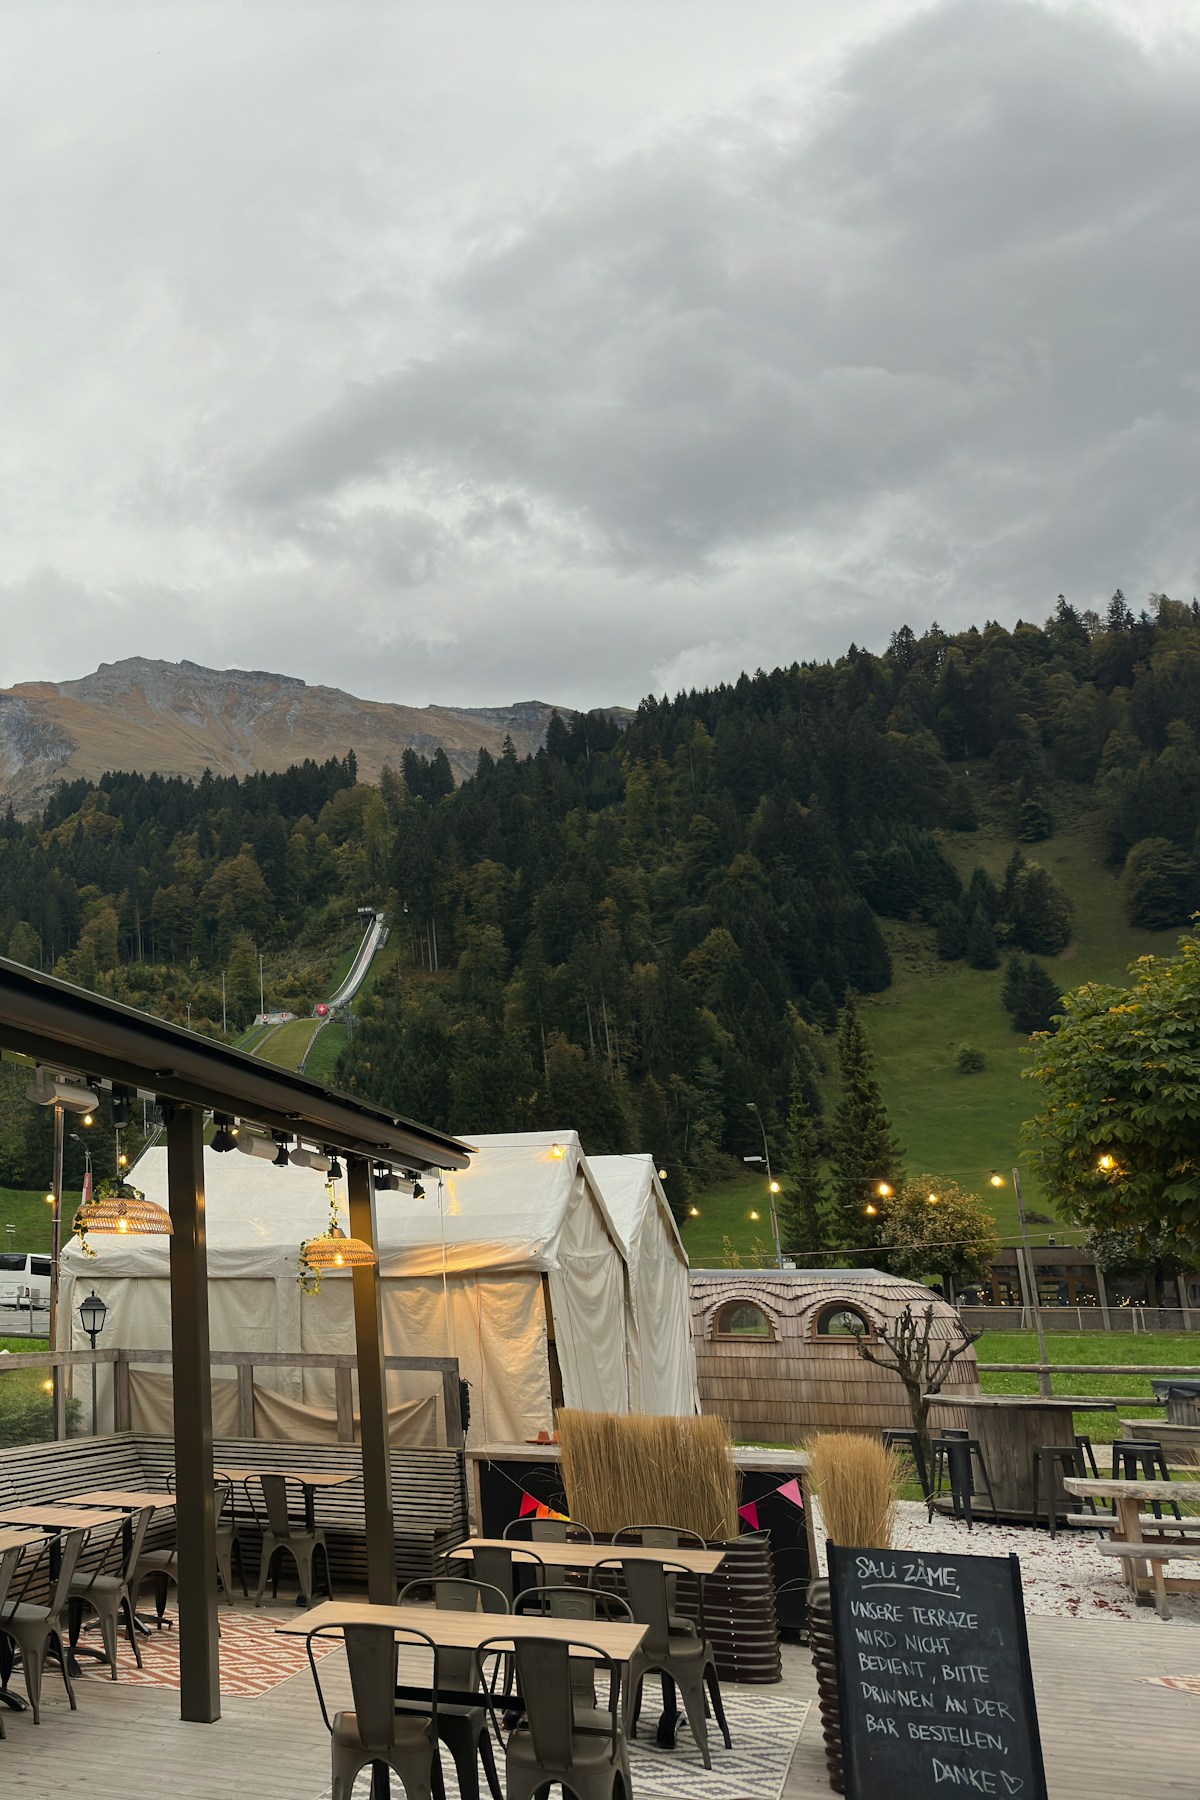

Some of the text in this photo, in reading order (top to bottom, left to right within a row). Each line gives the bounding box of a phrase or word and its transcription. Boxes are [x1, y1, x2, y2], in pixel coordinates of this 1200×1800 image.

[850, 1600, 978, 1630] UNSERE TERRAZE
[855, 1627, 950, 1656] WIRD NICHT
[941, 1664, 990, 1684] BITTE
[860, 1681, 1016, 1722] DRINNEN AN DER
[865, 1713, 1008, 1755] BAR BESTELLEN,
[932, 1757, 997, 1794] DANKE
